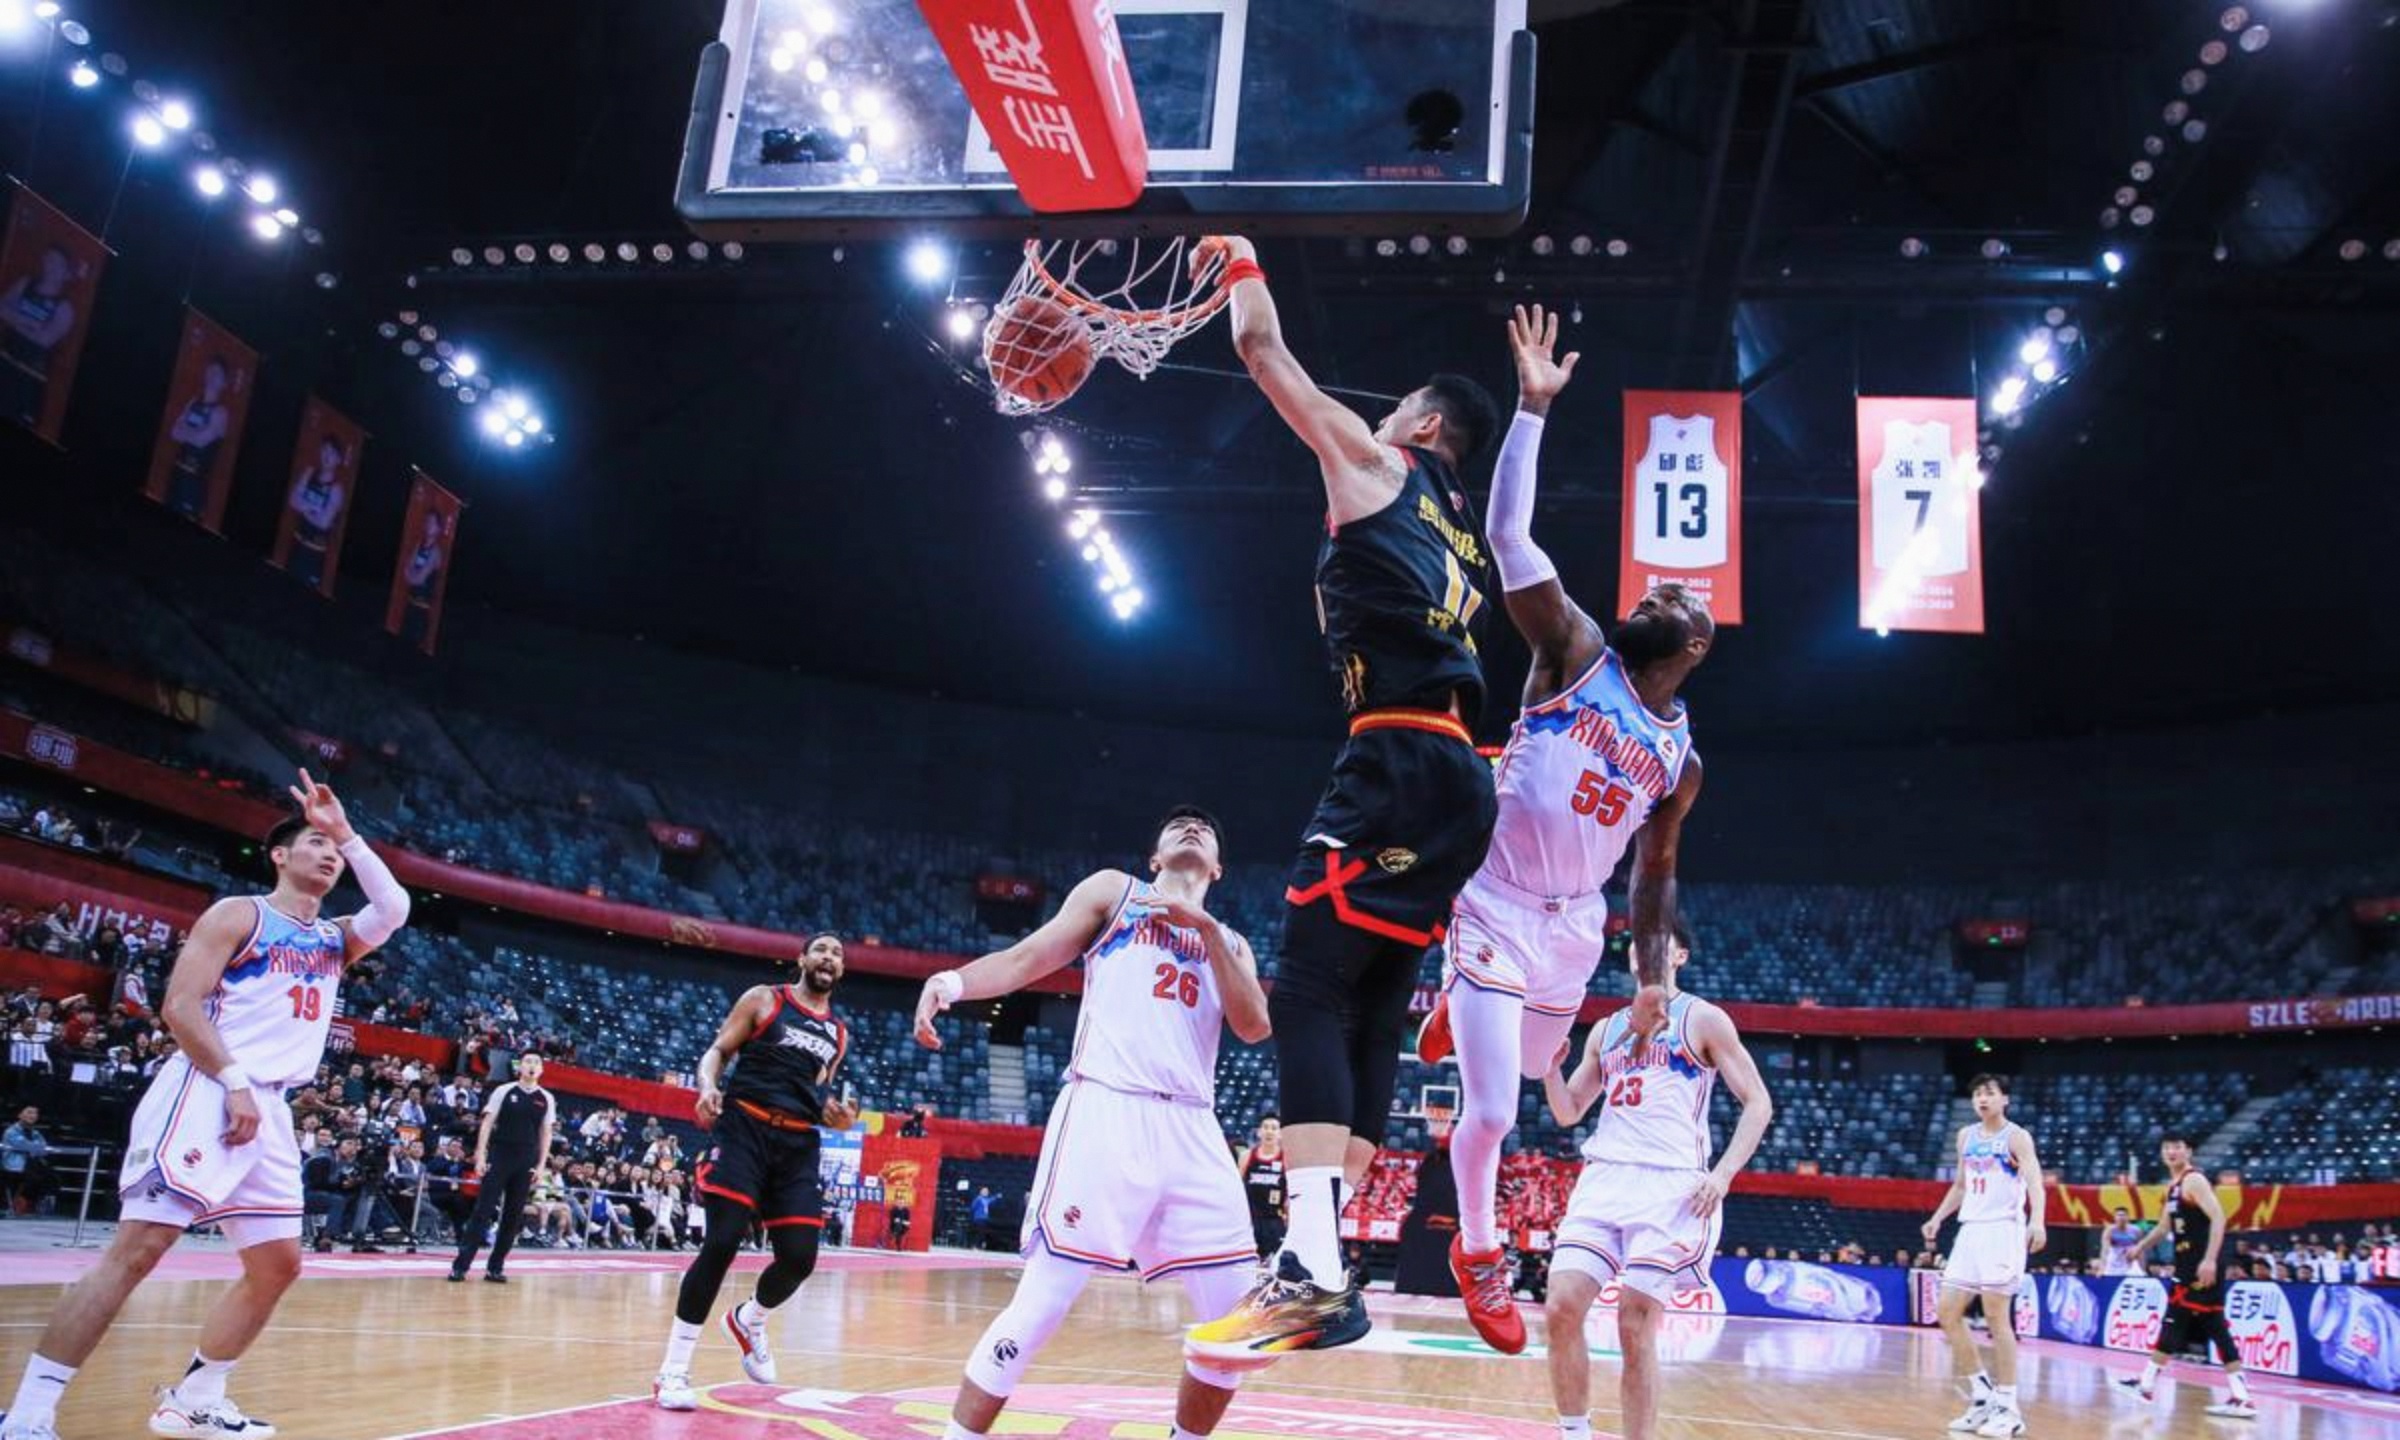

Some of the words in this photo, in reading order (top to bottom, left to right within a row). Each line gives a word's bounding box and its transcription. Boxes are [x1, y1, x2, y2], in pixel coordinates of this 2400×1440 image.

[1654, 482, 1708, 538] 13
[1905, 490, 1932, 538] 7
[1571, 768, 1634, 827] 55
[287, 985, 321, 1022] 19
[1153, 962, 1200, 1009] 26
[1609, 1077, 1643, 1107] 23
